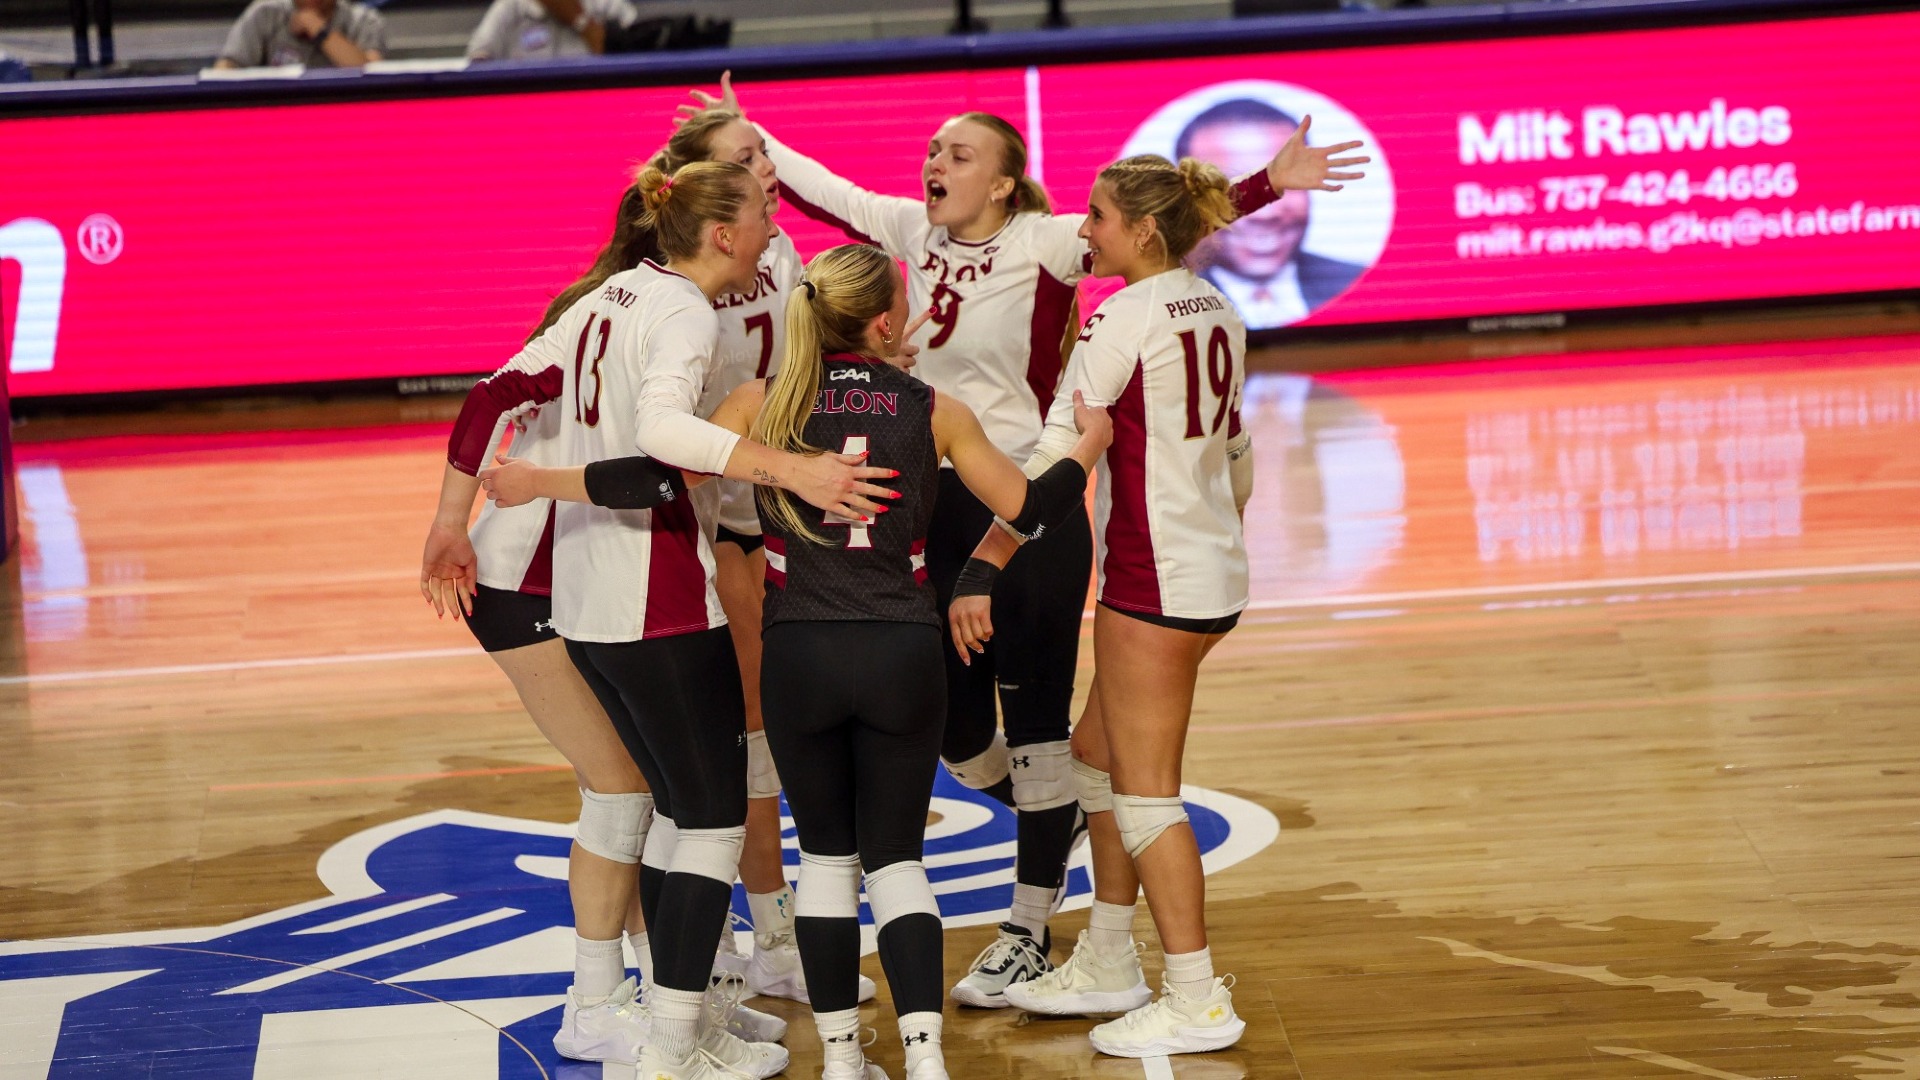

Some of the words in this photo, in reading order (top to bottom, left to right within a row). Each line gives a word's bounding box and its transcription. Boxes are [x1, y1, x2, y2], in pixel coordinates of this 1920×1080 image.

[1457, 109, 1574, 165] Milt
[1582, 98, 1793, 157] Rawles
[1454, 181, 1535, 218] Bus:
[743, 309, 774, 380] 7
[927, 283, 964, 349] 9
[575, 310, 612, 429] 13
[829, 368, 871, 383] CAA
[1173, 324, 1233, 441] 19
